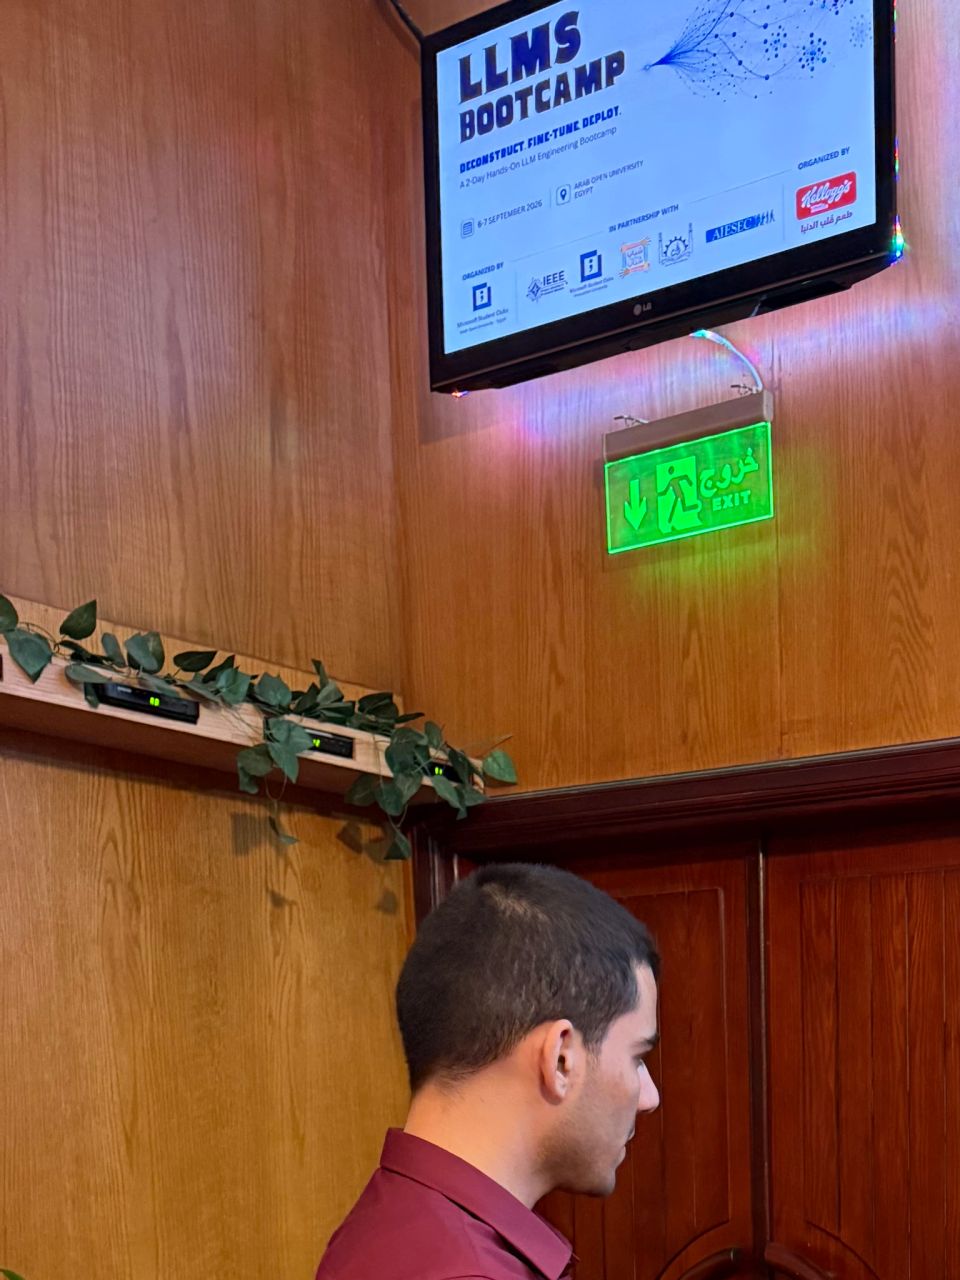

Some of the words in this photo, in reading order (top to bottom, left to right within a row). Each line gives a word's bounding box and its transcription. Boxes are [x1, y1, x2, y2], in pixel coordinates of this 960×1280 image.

[459, 11, 581, 105] LLMS
[459, 50, 624, 144] BOOTCAMP
[459, 181, 465, 189] A
[465, 175, 486, 187] 2-Day
[486, 161, 521, 179] Hands-On
[521, 155, 536, 167] LLM
[537, 140, 579, 161] Engineering
[579, 126, 617, 146] Bootcamp
[797, 150, 839, 170] ORGANIZED
[841, 146, 850, 156] BY
[574, 178, 591, 190] ARAB
[590, 173, 608, 184] OPEN
[608, 159, 644, 178] UNIVERSITY
[574, 186, 593, 199] EGYPT
[800, 179, 853, 209] Kellogg's
[488, 205, 526, 225] SEPTEMBER
[617, 210, 660, 230] PARTNERSHIP
[661, 203, 679, 216] WITH
[712, 217, 753, 241] AIESEC
[462, 264, 496, 281] ORGANIZED
[496, 261, 504, 270] BY
[543, 270, 565, 286] IEEE
[700, 448, 759, 498] خروج
[713, 489, 751, 512] EXIT
